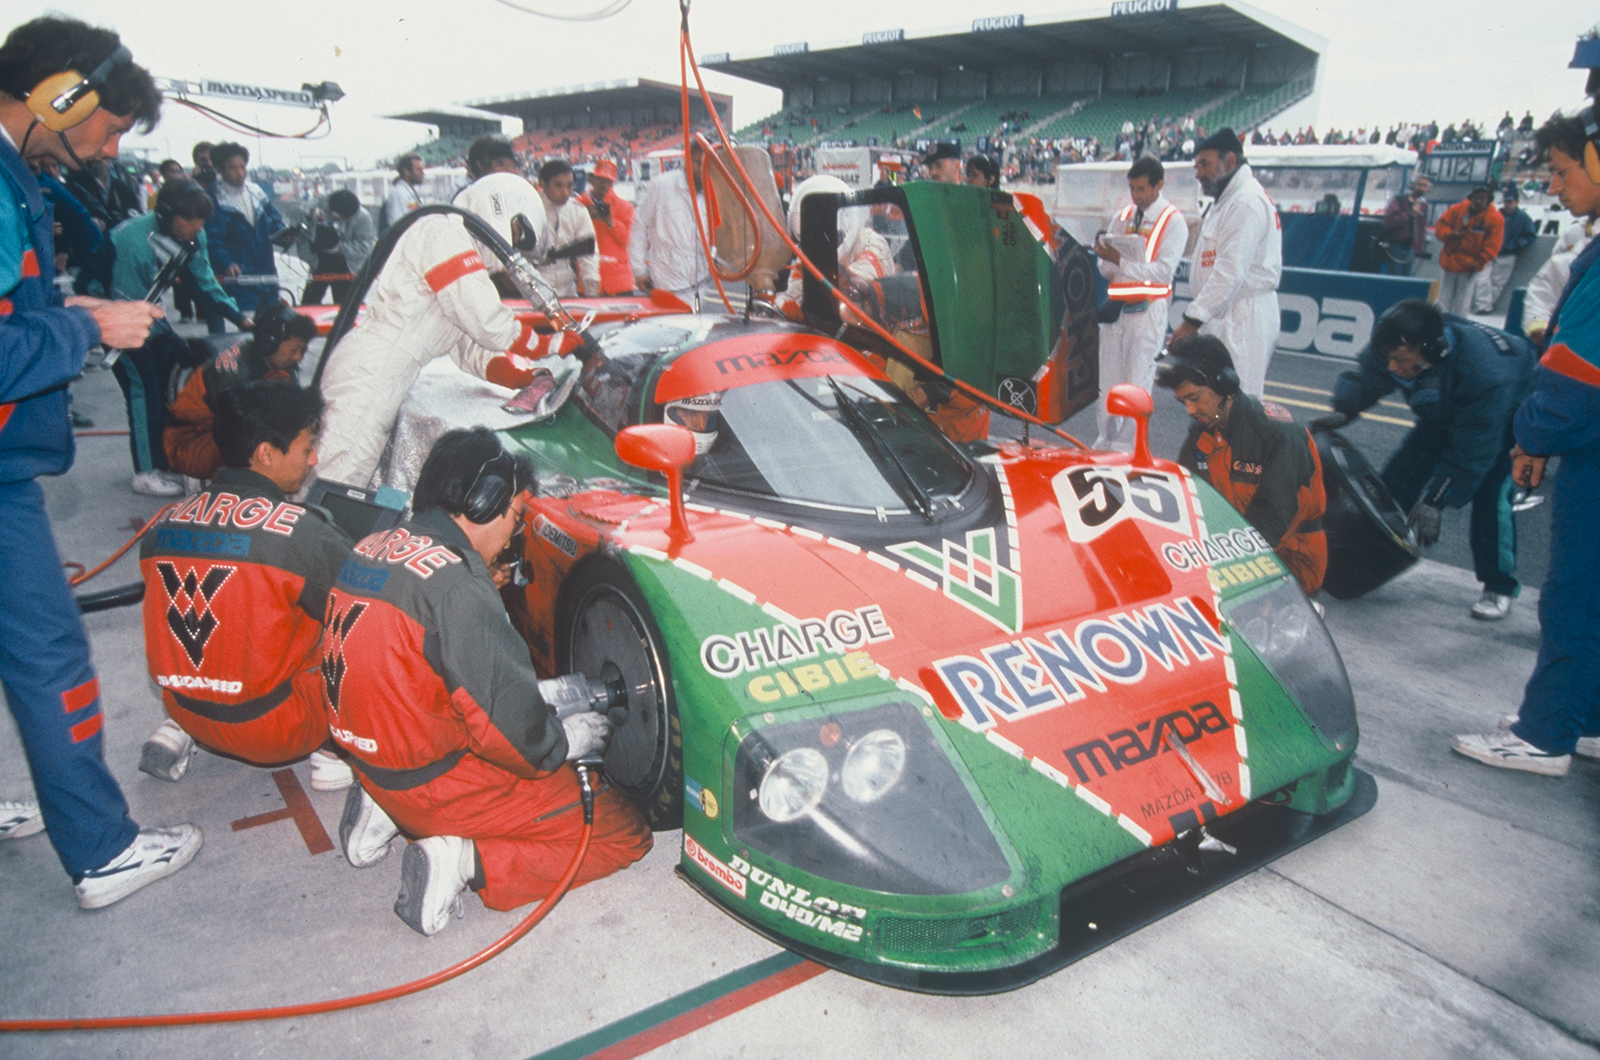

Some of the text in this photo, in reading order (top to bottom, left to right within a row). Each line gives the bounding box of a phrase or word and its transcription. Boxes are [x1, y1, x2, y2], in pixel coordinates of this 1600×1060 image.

[974, 16, 1021, 31] PEUGEOT
[1113, 0, 1170, 15] PEUGEOT
[714, 349, 850, 375] mazda
[1066, 467, 1181, 527] 55
[541, 522, 578, 557] IDEMITSU
[1161, 526, 1273, 572] CHARGE
[1207, 556, 1282, 588] CIBIE
[700, 604, 895, 680] CHARGE
[932, 597, 1232, 734] RENOWN
[748, 650, 881, 703] CIBIE
[1063, 700, 1232, 784] mazda
[1141, 785, 1195, 820] MAZDA
[696, 842, 743, 891] brembo
[727, 854, 867, 920] DUNLOP
